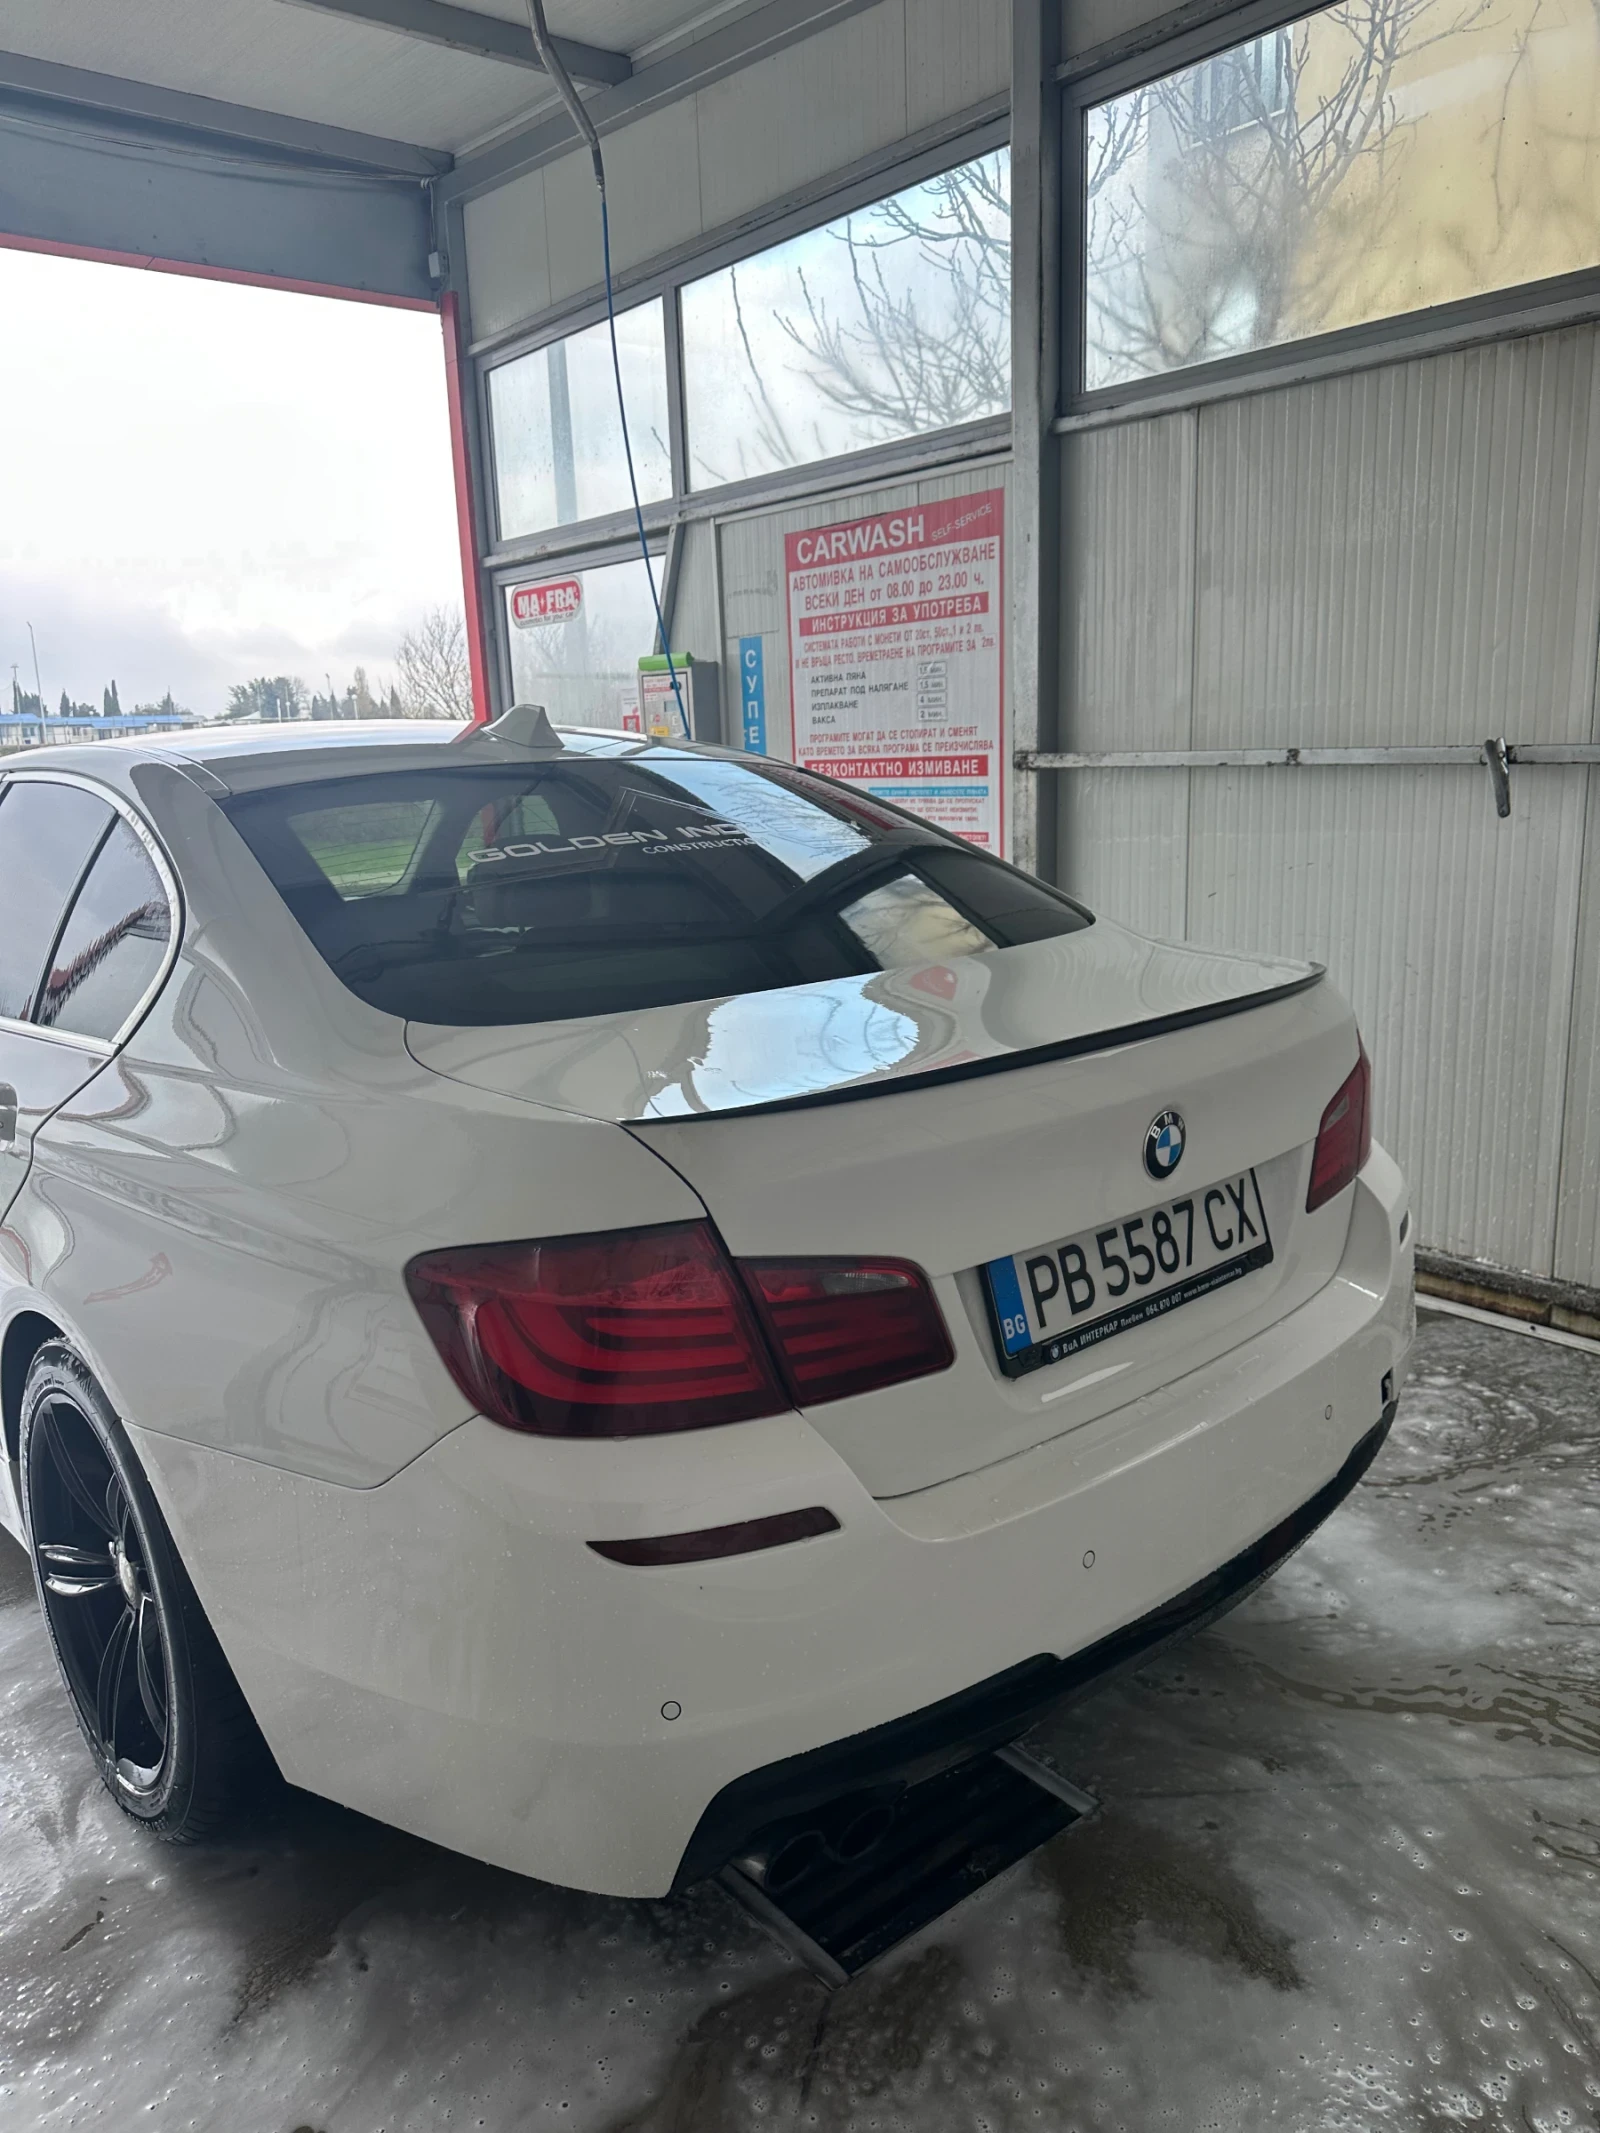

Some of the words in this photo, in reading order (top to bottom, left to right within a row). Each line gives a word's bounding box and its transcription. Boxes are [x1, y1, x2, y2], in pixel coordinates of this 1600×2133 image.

[797, 514, 924, 564] CARWASH
[931, 503, 993, 541] SELF-SERVICE
[793, 567, 855, 592] АВТОМИВКА
[859, 564, 874, 581] НА
[879, 542, 996, 578] САМООБСЛУЖВАНЕ
[805, 590, 840, 611] ВСЕКИ
[843, 587, 865, 608] ДЕН
[870, 588, 882, 601] от
[886, 580, 914, 599] 08.00
[919, 580, 933, 597] до
[938, 571, 968, 591] 23.00
[812, 609, 887, 633] ИНСТРУКЦИЯ
[891, 606, 908, 622] ЗА
[913, 595, 982, 619] УПОТРЕБА
[804, 638, 839, 653] СИСТЕМАТА
[874, 630, 902, 646] МОНЕТИ
[904, 629, 914, 642] ОТ
[918, 639, 964, 656] ПРОГРАМИТЕ
[966, 638, 976, 652] ЗА
[811, 672, 844, 684] АКТИВНА
[846, 671, 867, 681] ПЯНА
[811, 686, 848, 698] ПРЕПАРАТ
[850, 685, 866, 695] ПОД
[868, 681, 909, 692] НАЛЯГАНЕ
[745, 649, 760, 754] СУПЕ
[811, 699, 859, 711] ИЗПЛАКВАНЕ
[812, 715, 836, 725] ВАКСА
[798, 746, 815, 757] КАТО
[816, 745, 845, 756] ВРЕМЕТО
[847, 744, 856, 755] ЗА
[858, 744, 880, 755] ВСЯКА
[883, 741, 919, 754] ПРОГРАМА
[922, 741, 932, 753] СЕ
[934, 739, 994, 752] ПРЕИЗЧИСЛЯВА
[810, 732, 850, 744] ПРОГРАМИТЕ
[853, 731, 875, 742] МОГАТ
[876, 730, 886, 742] ДА
[888, 729, 898, 740] СЕ
[900, 727, 937, 740] СТОПИРАТ
[939, 727, 945, 737] И
[948, 725, 978, 738] СМЕНЯТ
[811, 760, 903, 778] БЕЗКОНТАКТНО
[908, 758, 979, 776] ИЗМИВАНЕ
[467, 828, 669, 864] GOLDEN
[1150, 1112, 1184, 1139] BMW
[1025, 1243, 1096, 1329] PB
[1096, 1199, 1194, 1297] 5587
[1204, 1178, 1258, 1251] CX
[1003, 1313, 1026, 1340] BG
[1080, 1320, 1118, 1346] ИНТЕРКАР
[1120, 1311, 1144, 1327] Плевен
